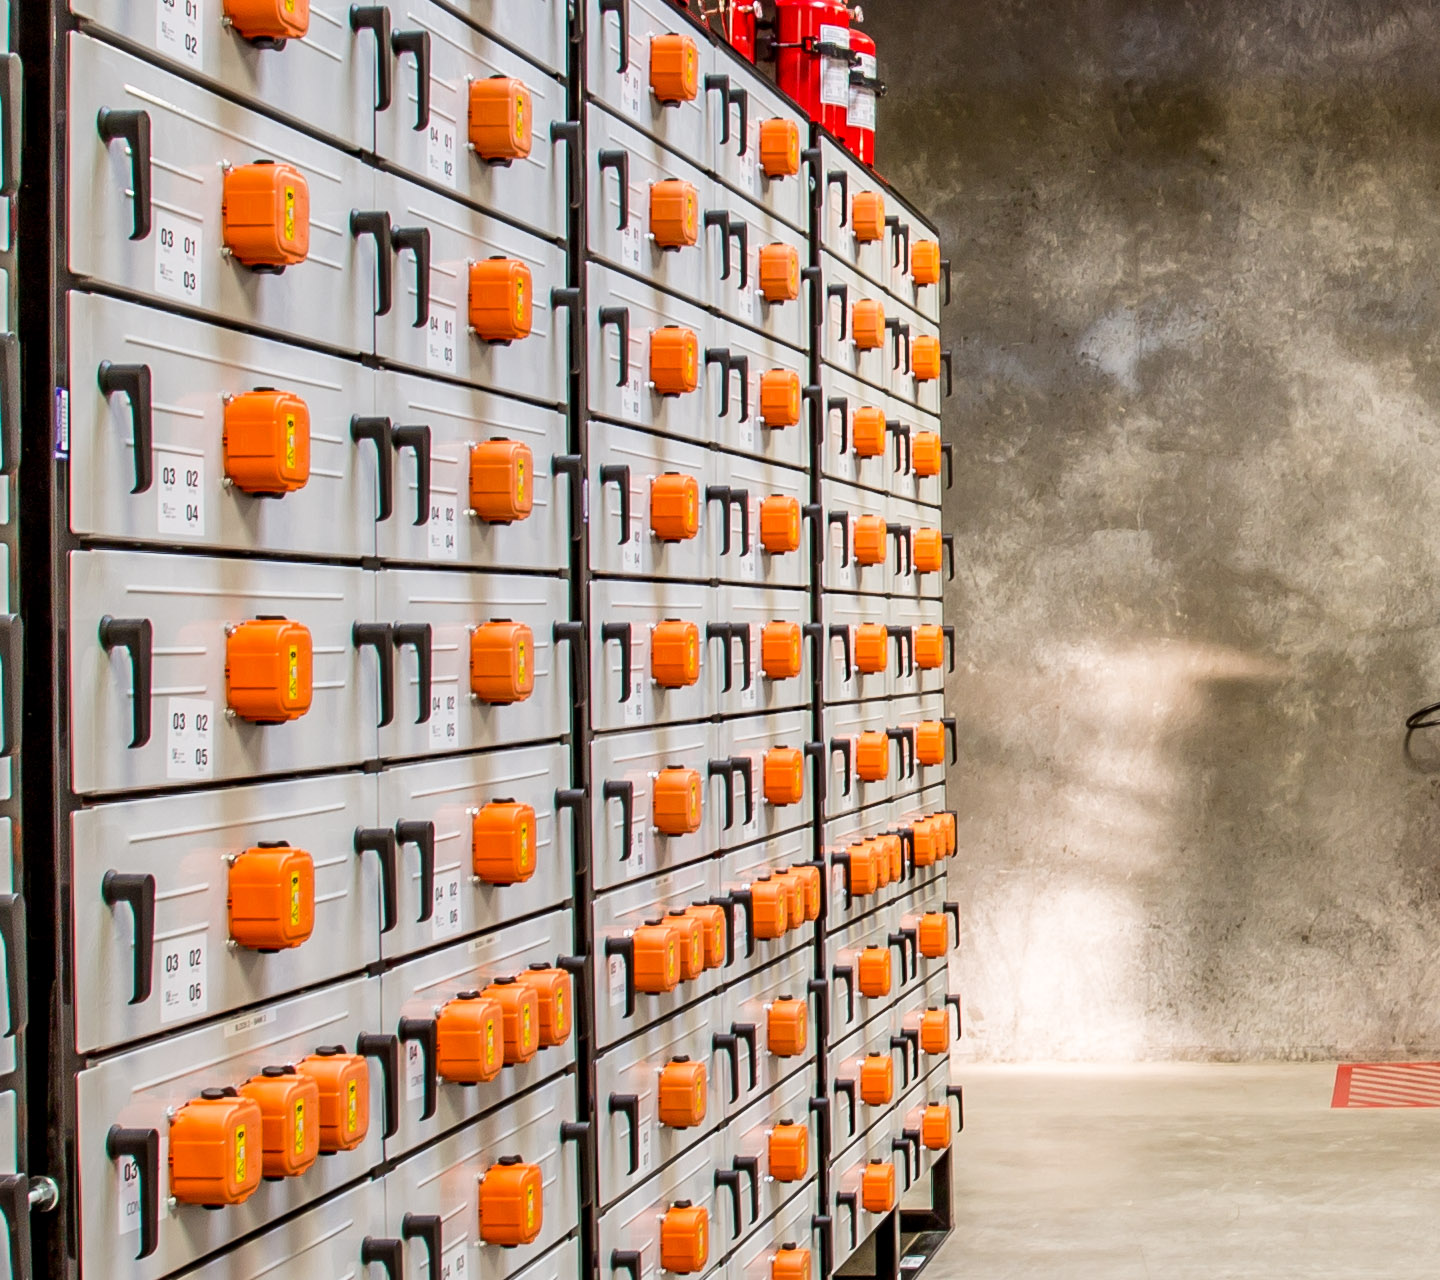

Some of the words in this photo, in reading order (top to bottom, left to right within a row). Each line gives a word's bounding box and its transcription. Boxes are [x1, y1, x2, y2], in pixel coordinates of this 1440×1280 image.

[162, 466, 176, 486] 03
[186, 469, 199, 488] 02
[186, 504, 199, 522] 04
[172, 712, 186, 731] 03
[195, 713, 208, 732] 02
[195, 748, 208, 766] 05
[165, 953, 179, 973] 03
[189, 948, 202, 968] 02
[189, 982, 202, 1002] 06
